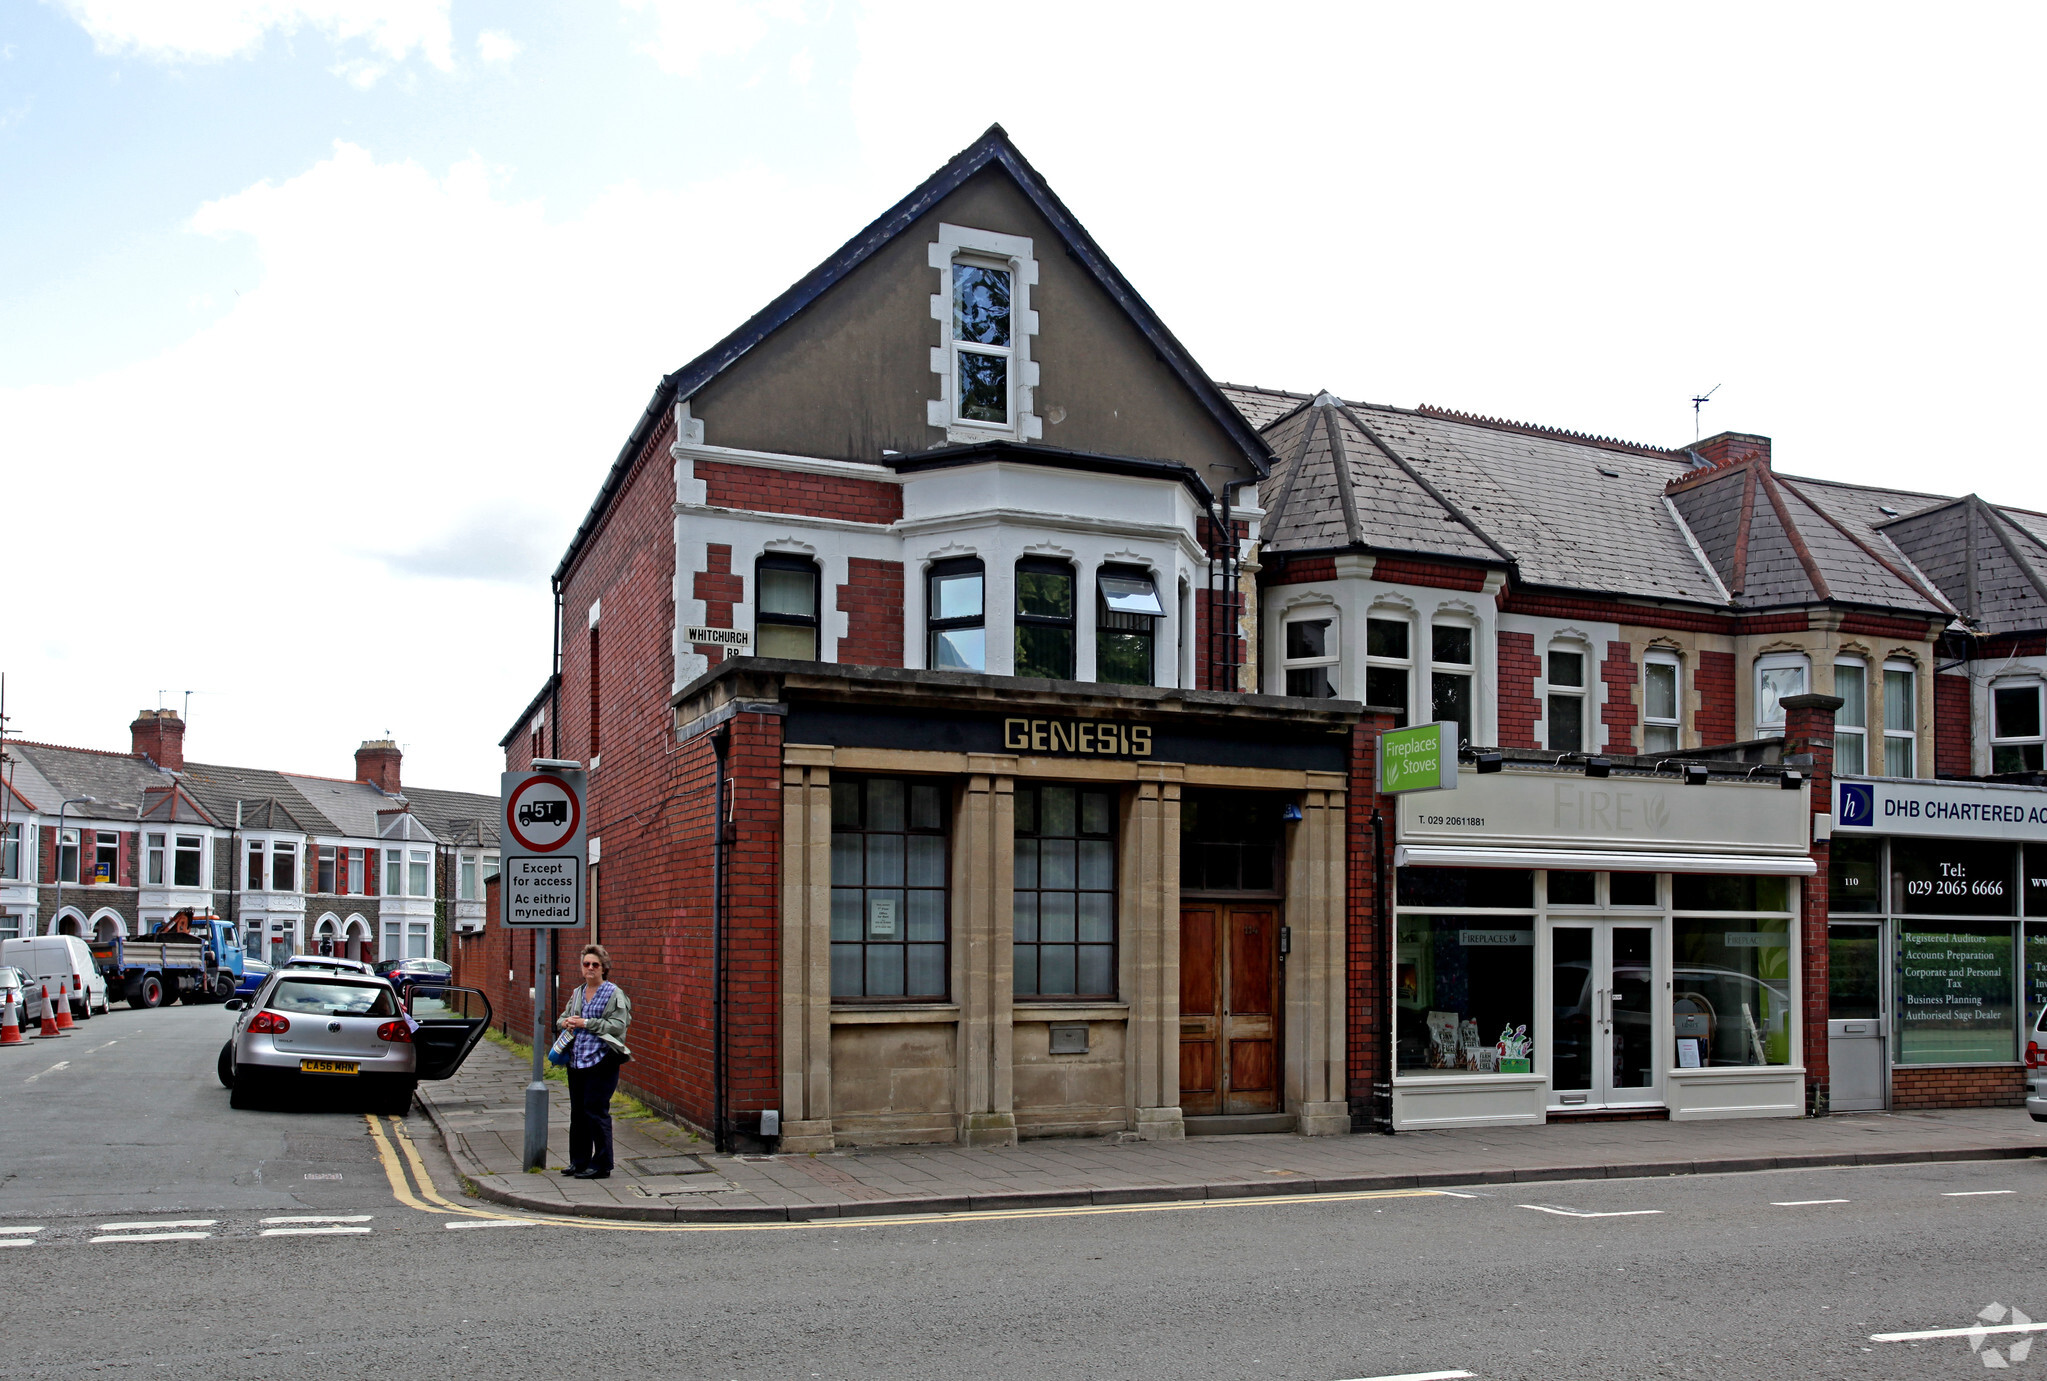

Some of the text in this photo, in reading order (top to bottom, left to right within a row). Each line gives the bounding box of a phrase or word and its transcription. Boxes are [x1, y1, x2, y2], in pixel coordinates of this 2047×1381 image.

[689, 628, 748, 644] WHITCHURCH
[1005, 718, 1151, 755] GENESIS
[1387, 738, 1436, 758] Fireplaces
[1403, 759, 1436, 775] Stoves
[535, 803, 553, 818] 5T
[1554, 782, 1633, 831] FIRE
[1885, 799, 1919, 817] DHB
[1925, 801, 2024, 822] CHARTERED
[1418, 815, 1484, 826] T. 029 20611881
[523, 863, 562, 874] Except
[1940, 863, 1965, 877] Tel:
[513, 876, 572, 886] for access
[1908, 880, 2003, 895] 029 2065 6666
[515, 894, 571, 903] Ac eithrio
[515, 907, 570, 918] mynediad
[1463, 932, 1508, 943] FIREPLACES
[1727, 934, 1767, 944] FIREPLAC
[1906, 933, 1986, 945] Registered Auditors
[1906, 950, 1994, 962] Accounts Preparation
[1906, 967, 2001, 979] Corporate and Personal
[1946, 979, 1962, 988] Tax
[1907, 995, 1982, 1006] Business Planning
[1906, 1010, 2002, 1021] Authorised Sage Dealer
[306, 1061, 354, 1072] CA56 WHN
